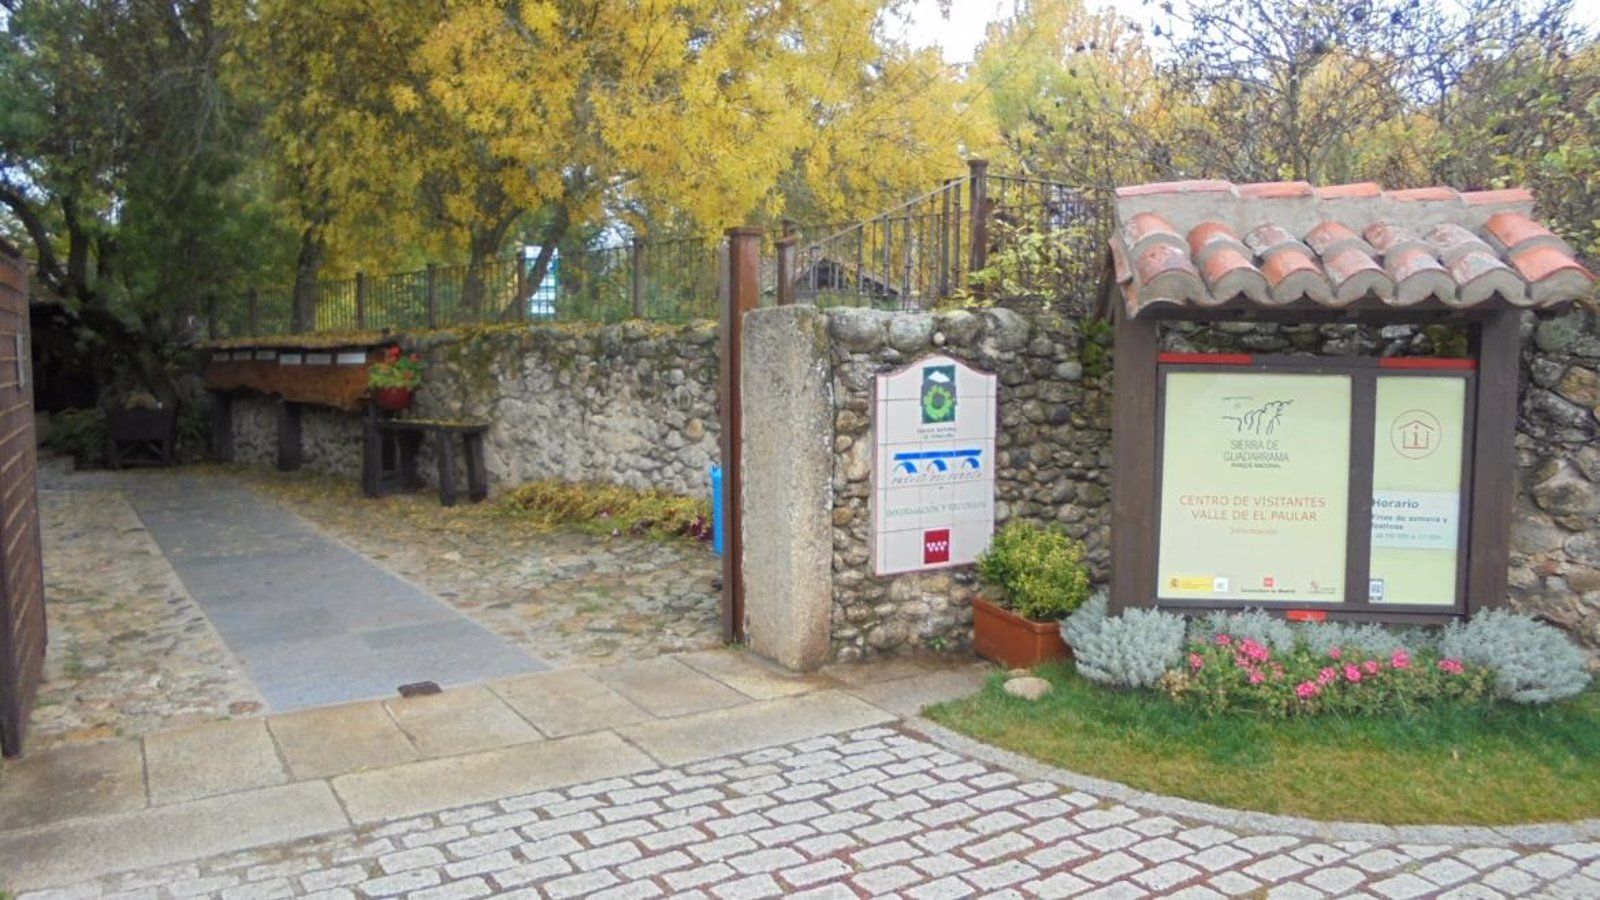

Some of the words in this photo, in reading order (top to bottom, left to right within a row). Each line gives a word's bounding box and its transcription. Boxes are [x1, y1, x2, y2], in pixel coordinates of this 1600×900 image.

[1230, 439, 1264, 450] SIERRA
[1267, 439, 1280, 450] DE
[1223, 451, 1290, 462] GUADARRAMA
[1179, 494, 1229, 506] CENTRO
[1233, 495, 1249, 506] DE
[1253, 496, 1326, 508] VISITANTES
[1371, 498, 1419, 509] Horario
[1191, 509, 1228, 520] VALLE
[1232, 510, 1249, 521] DE
[1253, 510, 1267, 521] EL
[1271, 510, 1318, 522] PAULAR
